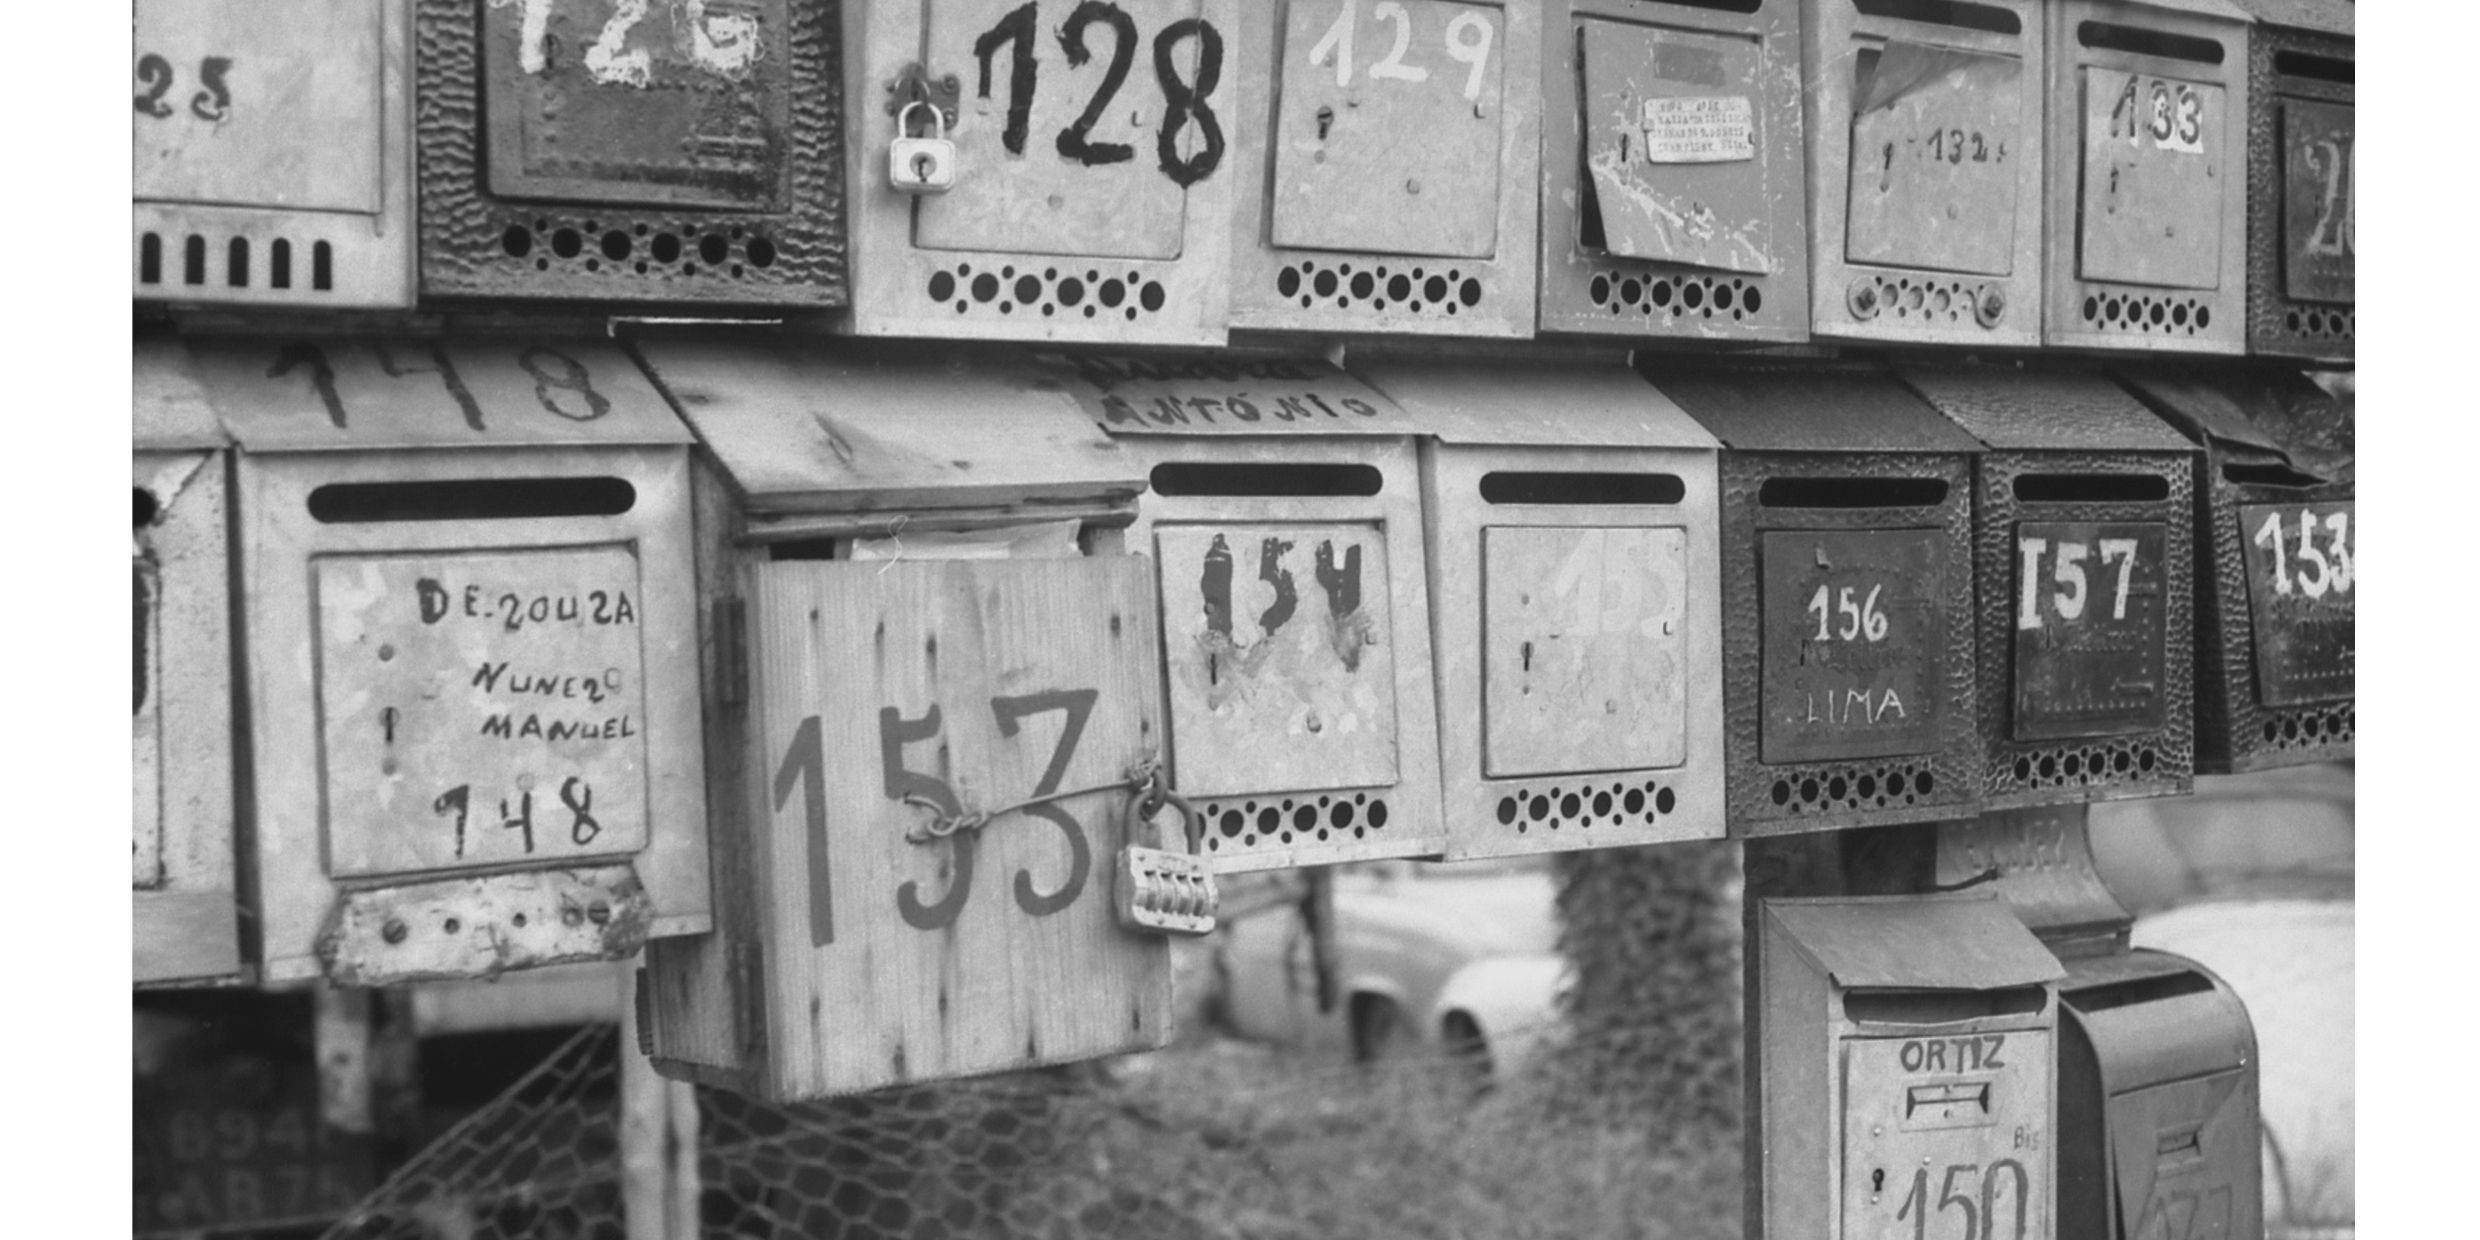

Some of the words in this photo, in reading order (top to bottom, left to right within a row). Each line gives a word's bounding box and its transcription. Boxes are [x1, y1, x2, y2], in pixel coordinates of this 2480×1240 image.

[1309, 0, 1493, 99] 129
[975, 0, 1225, 189] 128
[266, 338, 610, 432] 148
[1807, 582, 1889, 643] 156
[480, 713, 636, 742] MANUEL
[1808, 687, 1906, 725] LIMA
[434, 776, 601, 859] 148
[774, 688, 1099, 948] 153
[1900, 1035, 2007, 1075] ORTIZ
